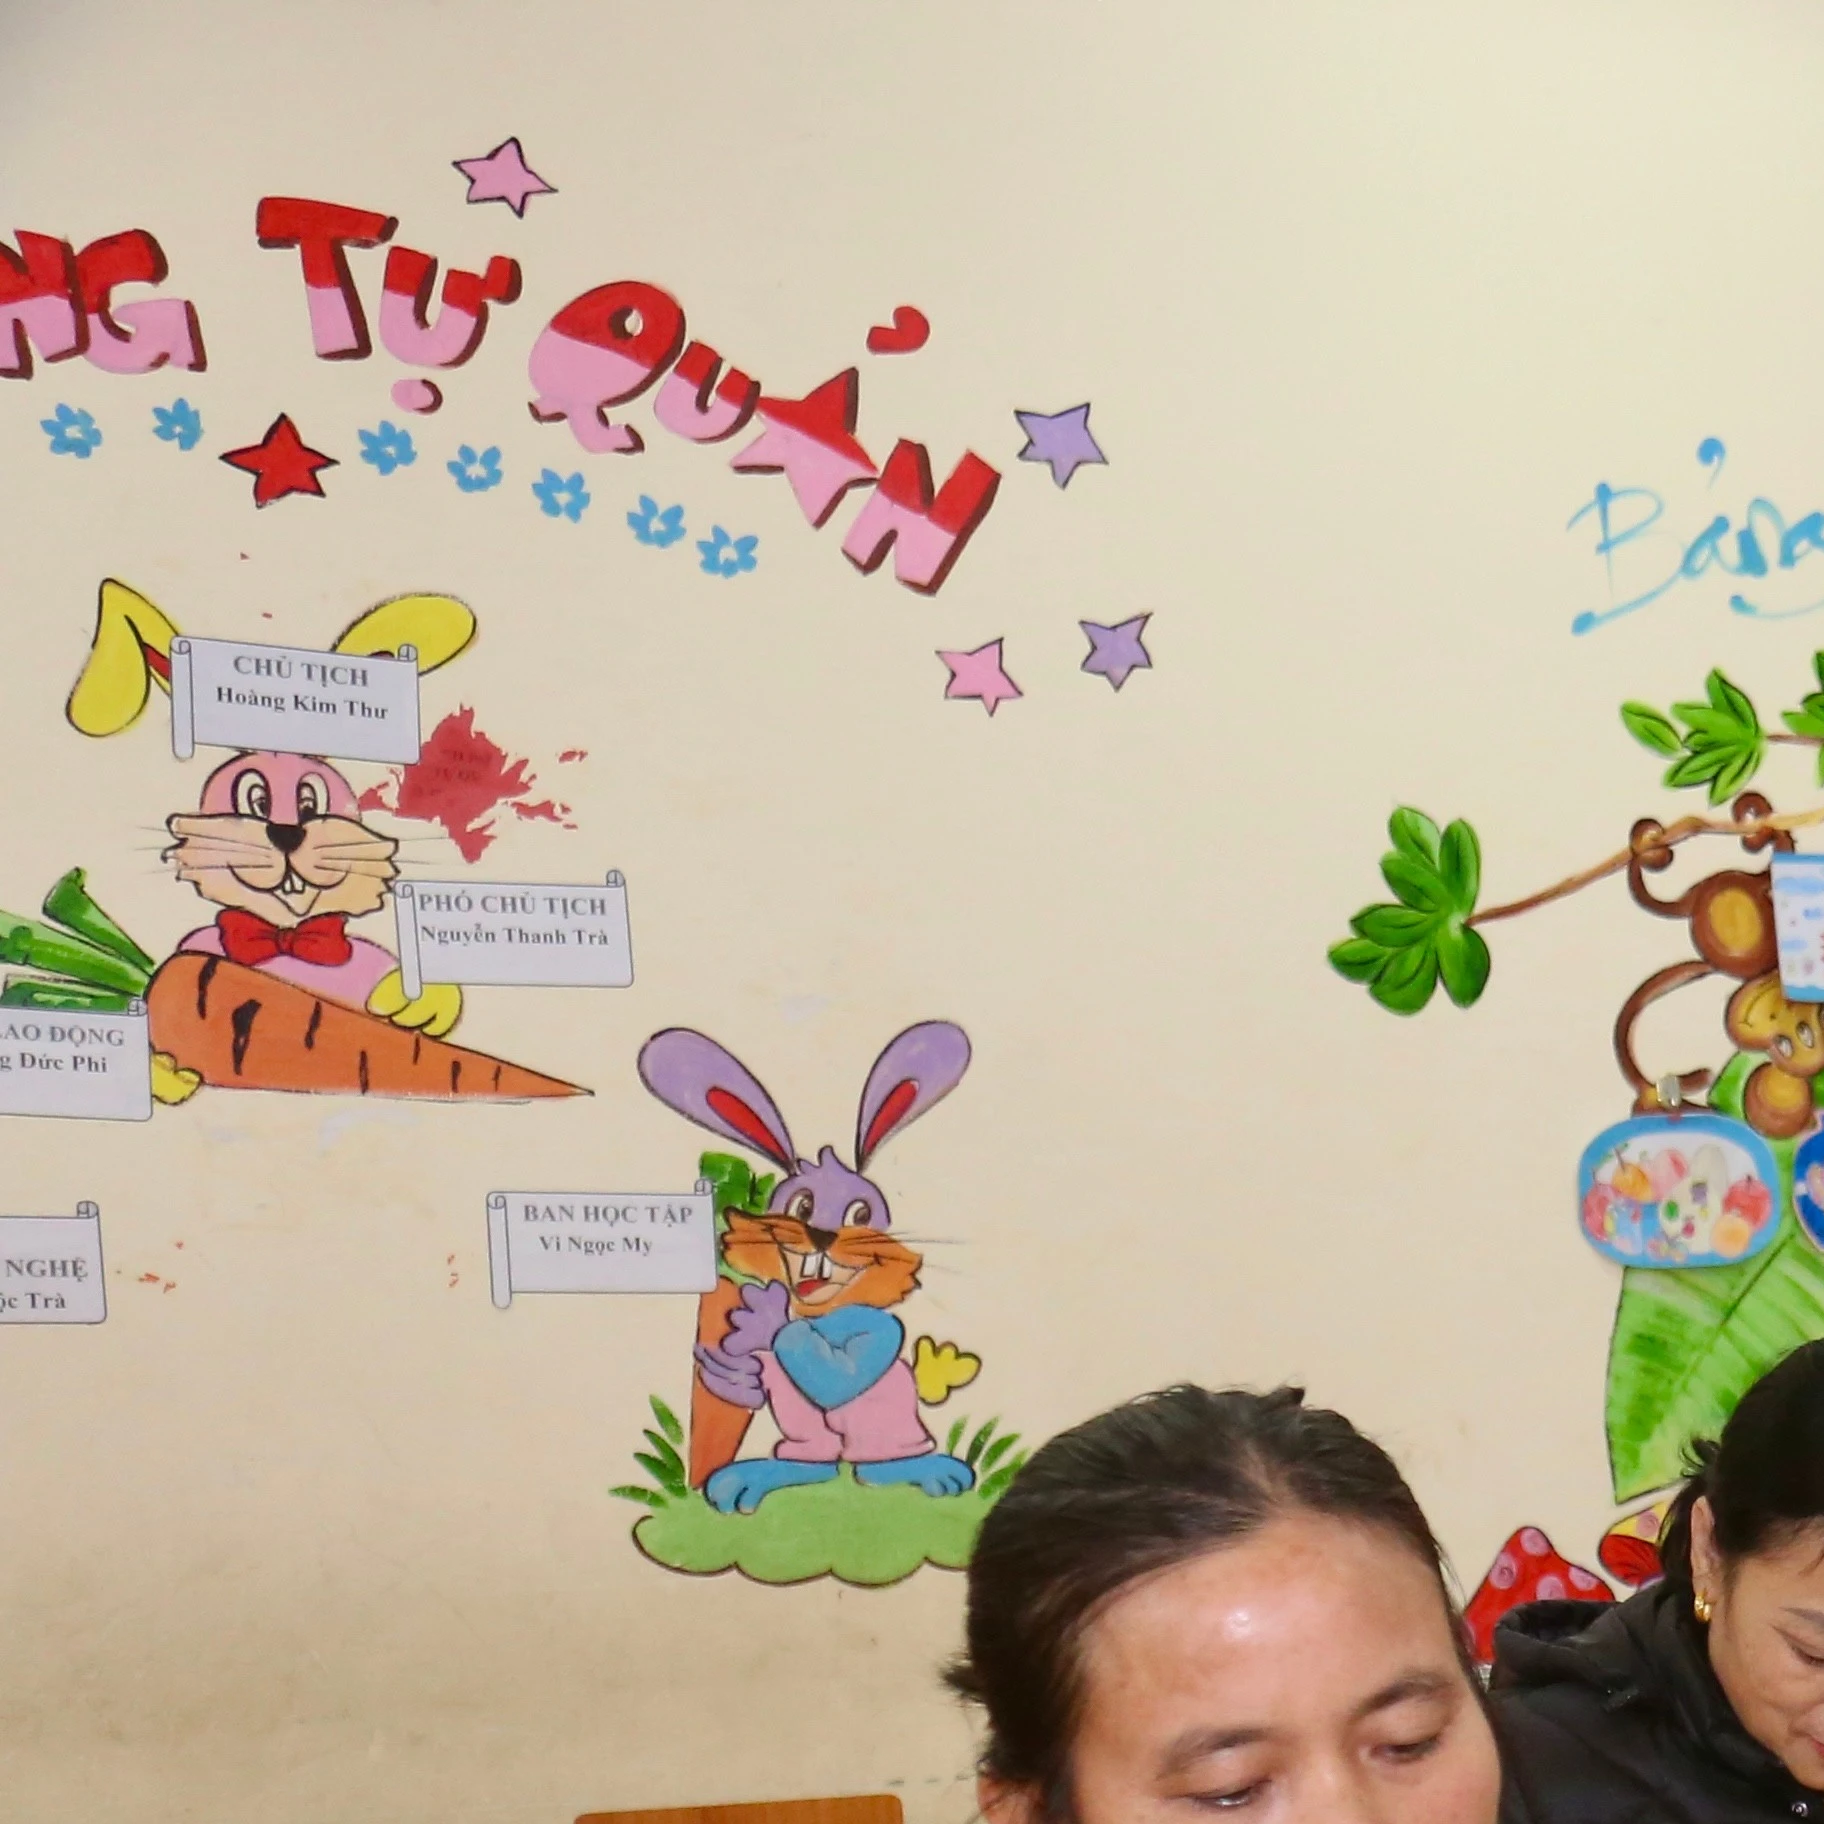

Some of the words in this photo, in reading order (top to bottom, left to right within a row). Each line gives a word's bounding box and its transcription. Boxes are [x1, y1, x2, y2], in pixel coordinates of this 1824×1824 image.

[232, 655, 293, 680] CHỦ
[300, 662, 369, 688] TỊCH
[216, 686, 286, 713] Hoàng
[293, 694, 337, 714] Kim
[344, 699, 389, 720] Thư
[418, 889, 473, 913] PHÓ
[480, 891, 537, 915] CHỦ
[543, 896, 607, 920] TỊCH
[420, 922, 496, 947] Nguyễn
[502, 927, 567, 945] Thanh
[573, 929, 609, 946] Trà
[0, 1023, 42, 1042] AO
[49, 1024, 125, 1048] ĐỘNG
[20, 1052, 64, 1071] Đức
[72, 1055, 108, 1073] Phi
[523, 1204, 575, 1223] BAN
[583, 1204, 639, 1228] HỌC
[645, 1203, 693, 1228] TẬP
[539, 1236, 562, 1252] Vi
[568, 1236, 616, 1256] Ngọc
[5, 1257, 88, 1282] NGHỆ
[24, 1292, 66, 1309] Trà
